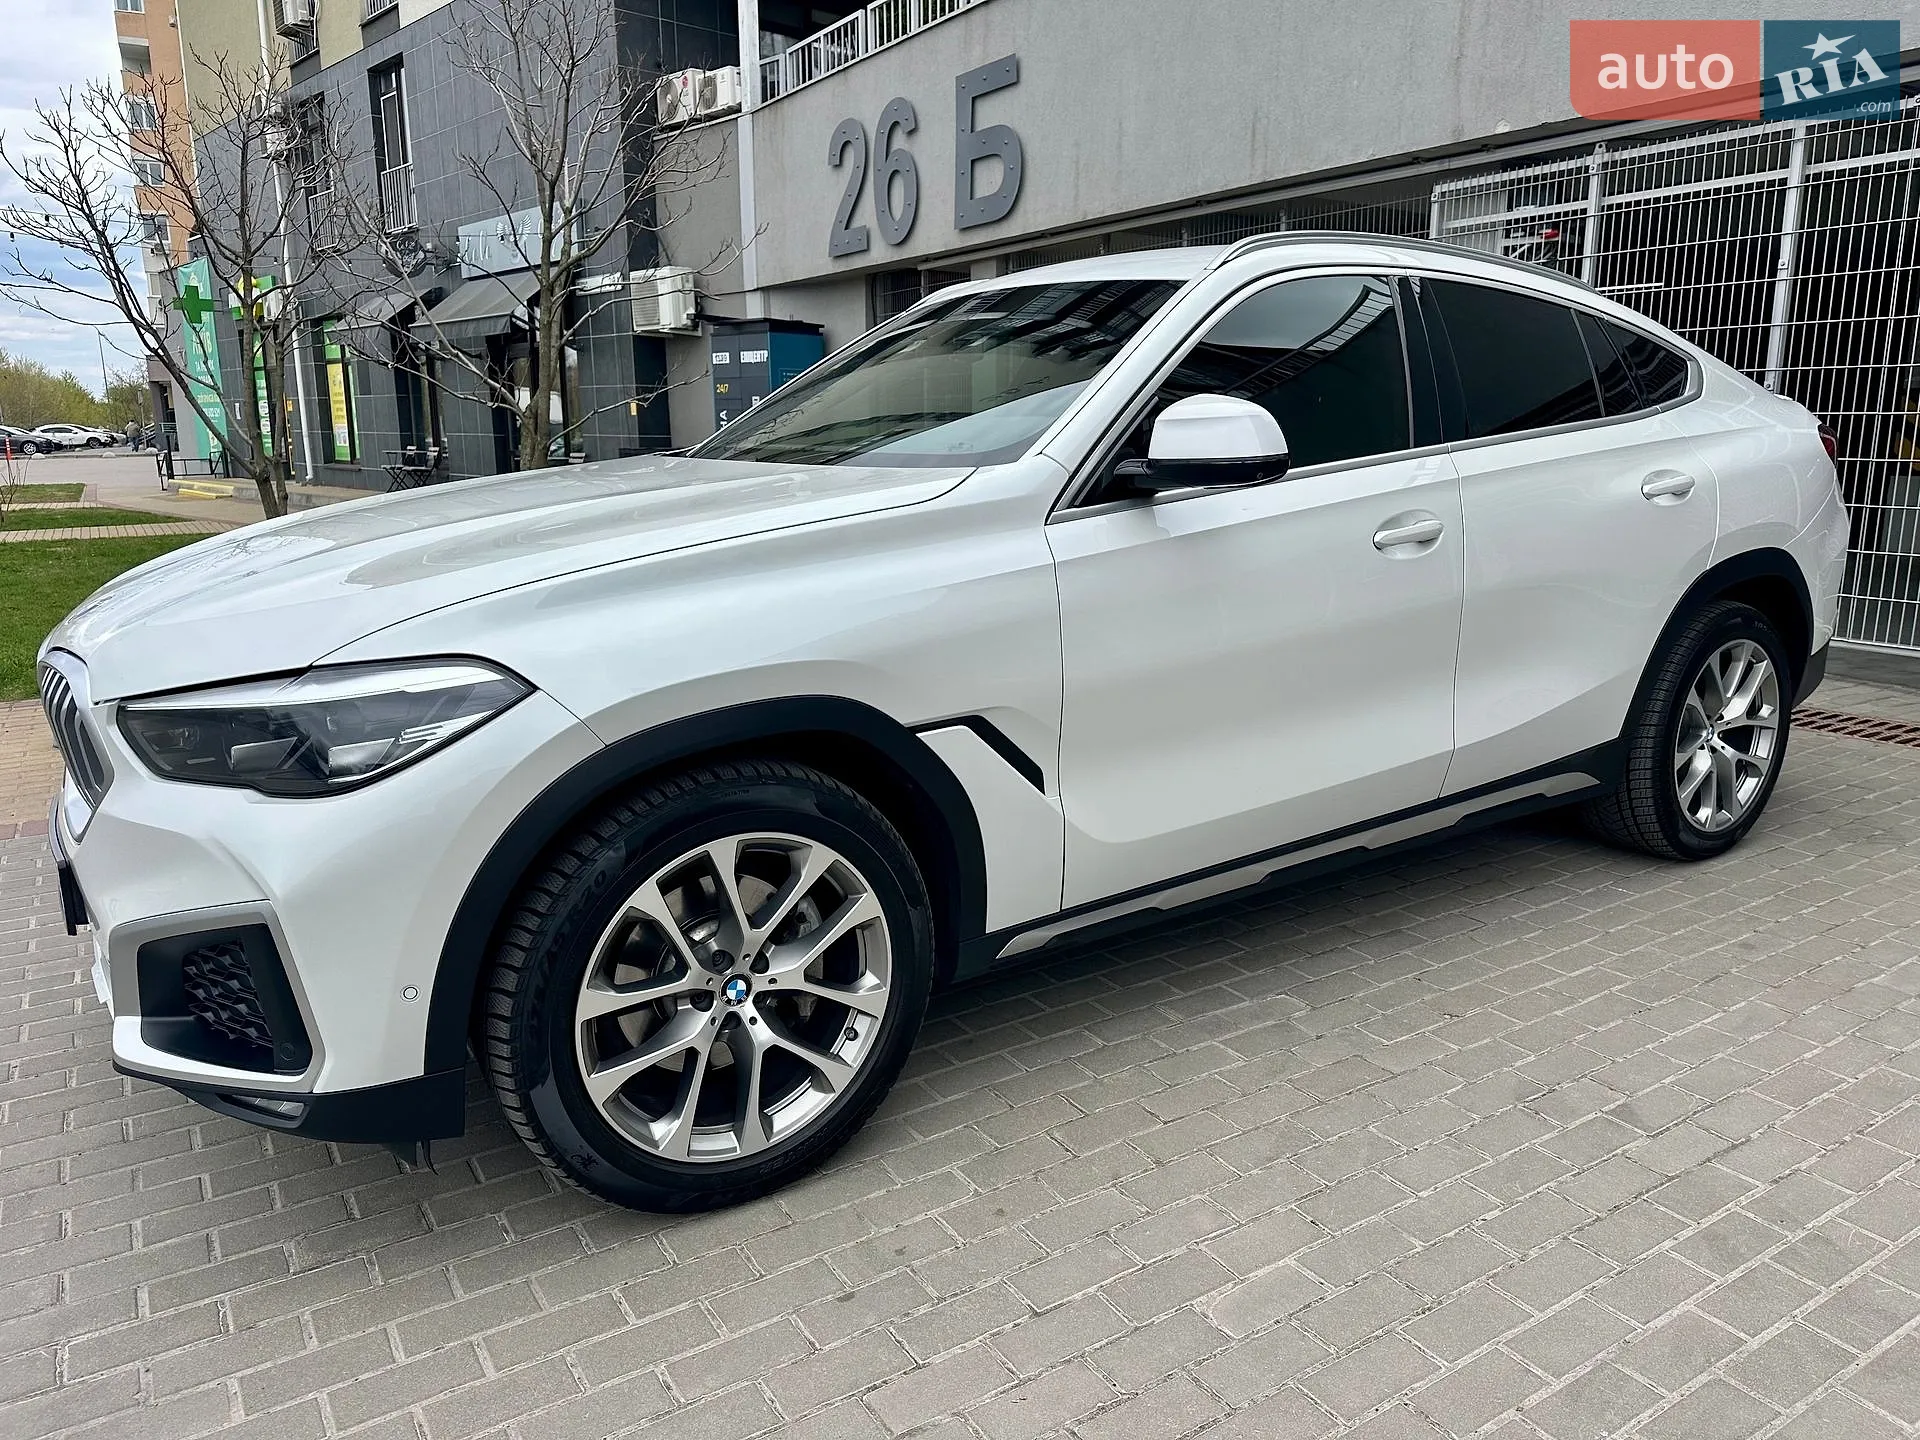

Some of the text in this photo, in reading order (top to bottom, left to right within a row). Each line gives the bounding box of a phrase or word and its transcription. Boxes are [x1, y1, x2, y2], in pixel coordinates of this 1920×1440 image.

[828, 53, 1022, 257] 26 Б
[716, 383, 729, 394] 24/7
